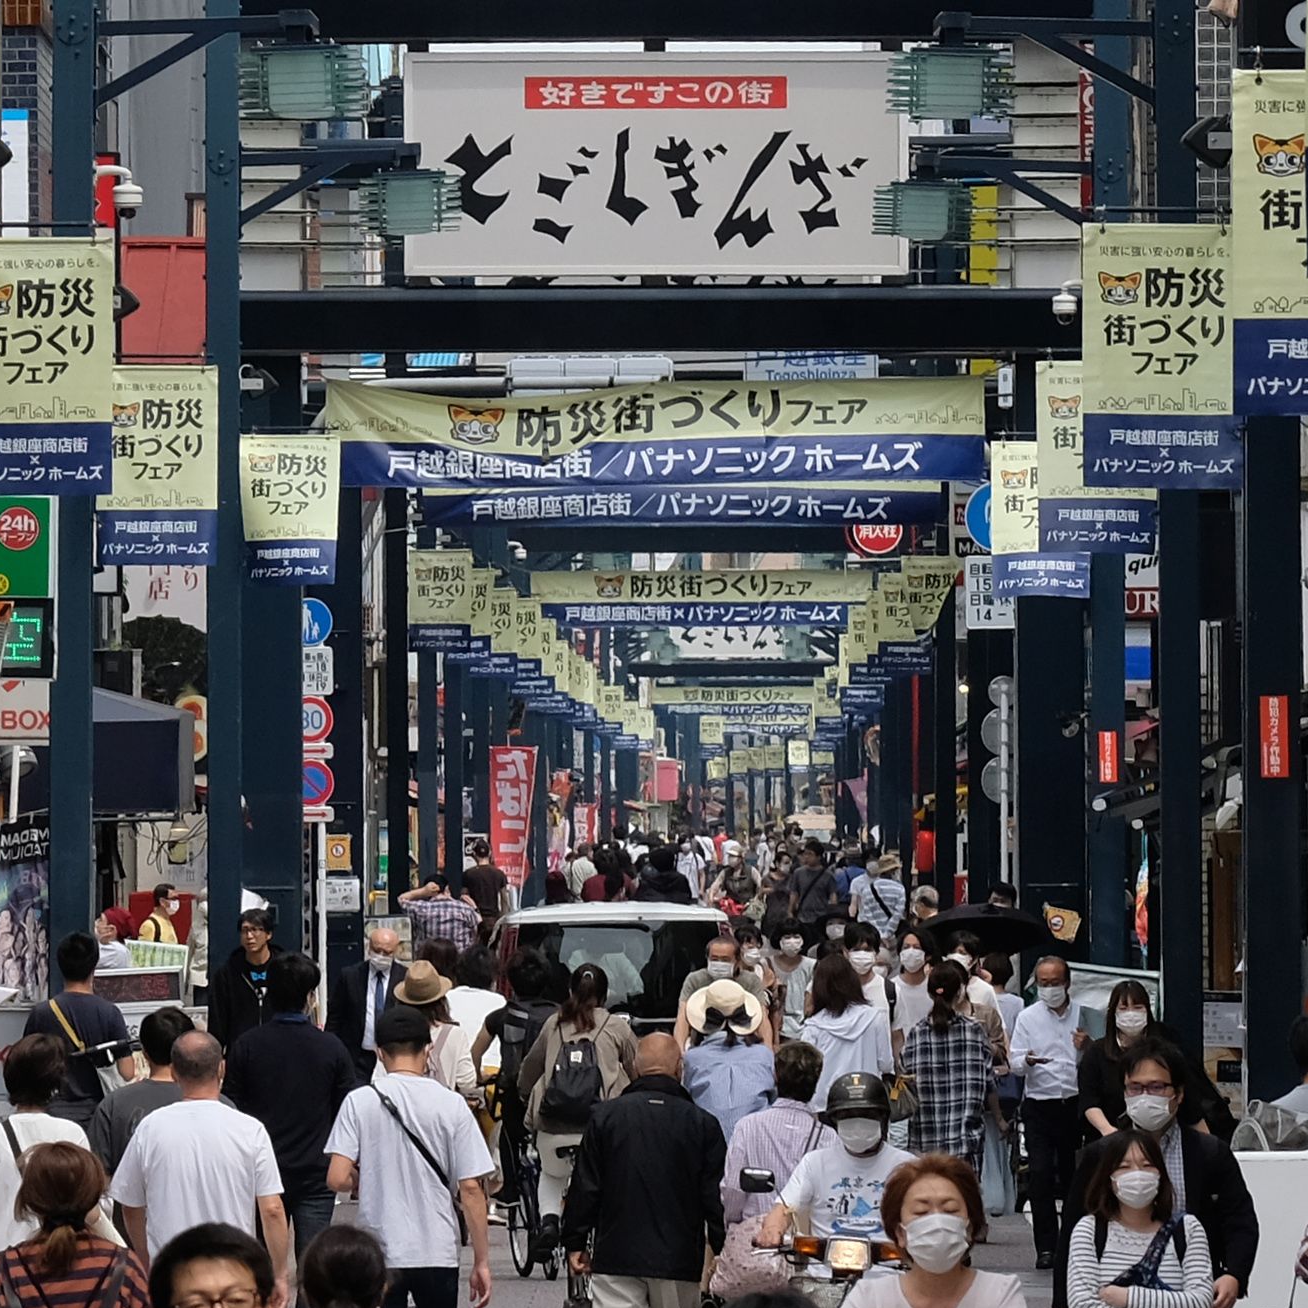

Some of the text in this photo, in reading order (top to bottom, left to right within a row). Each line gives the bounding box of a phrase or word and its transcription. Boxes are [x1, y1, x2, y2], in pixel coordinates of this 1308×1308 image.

[539, 81, 773, 105] 好きですこの街
[445, 127, 869, 250] とごしぎんざ
[17, 278, 95, 318] 防災
[1146, 267, 1225, 308] 防災
[1104, 315, 1224, 347] 街づくり
[3, 362, 68, 384] フェア
[1132, 352, 1198, 375] フェア
[143, 399, 203, 429] 防災
[516, 389, 869, 447] 防災街づくりフェア
[112, 432, 205, 460] 街づくり
[1110, 430, 1218, 450] 戸越銀座商店街
[278, 454, 326, 478] 防災
[805, 442, 922, 471] ホームズ
[1094, 458, 1234, 473] パナソニック ホームズ
[49, 465, 103, 480] ホームズ
[132, 463, 182, 479] フェア
[251, 479, 325, 498] 街づくり
[267, 501, 308, 515] フェア
[798, 490, 894, 518] ホームズ
[0, 515, 34, 533] 24h
[115, 521, 197, 533] 戸越銀座商店街
[1047, 531, 1150, 543] パナソニック ホームズ
[103, 543, 209, 554] パナソニック ホームズ
[433, 566, 466, 582] 防災
[630, 571, 812, 598] 防災街づくりフェア
[428, 599, 455, 609] フェア
[780, 603, 841, 621] ホームズ
[976, 609, 992, 621] 14
